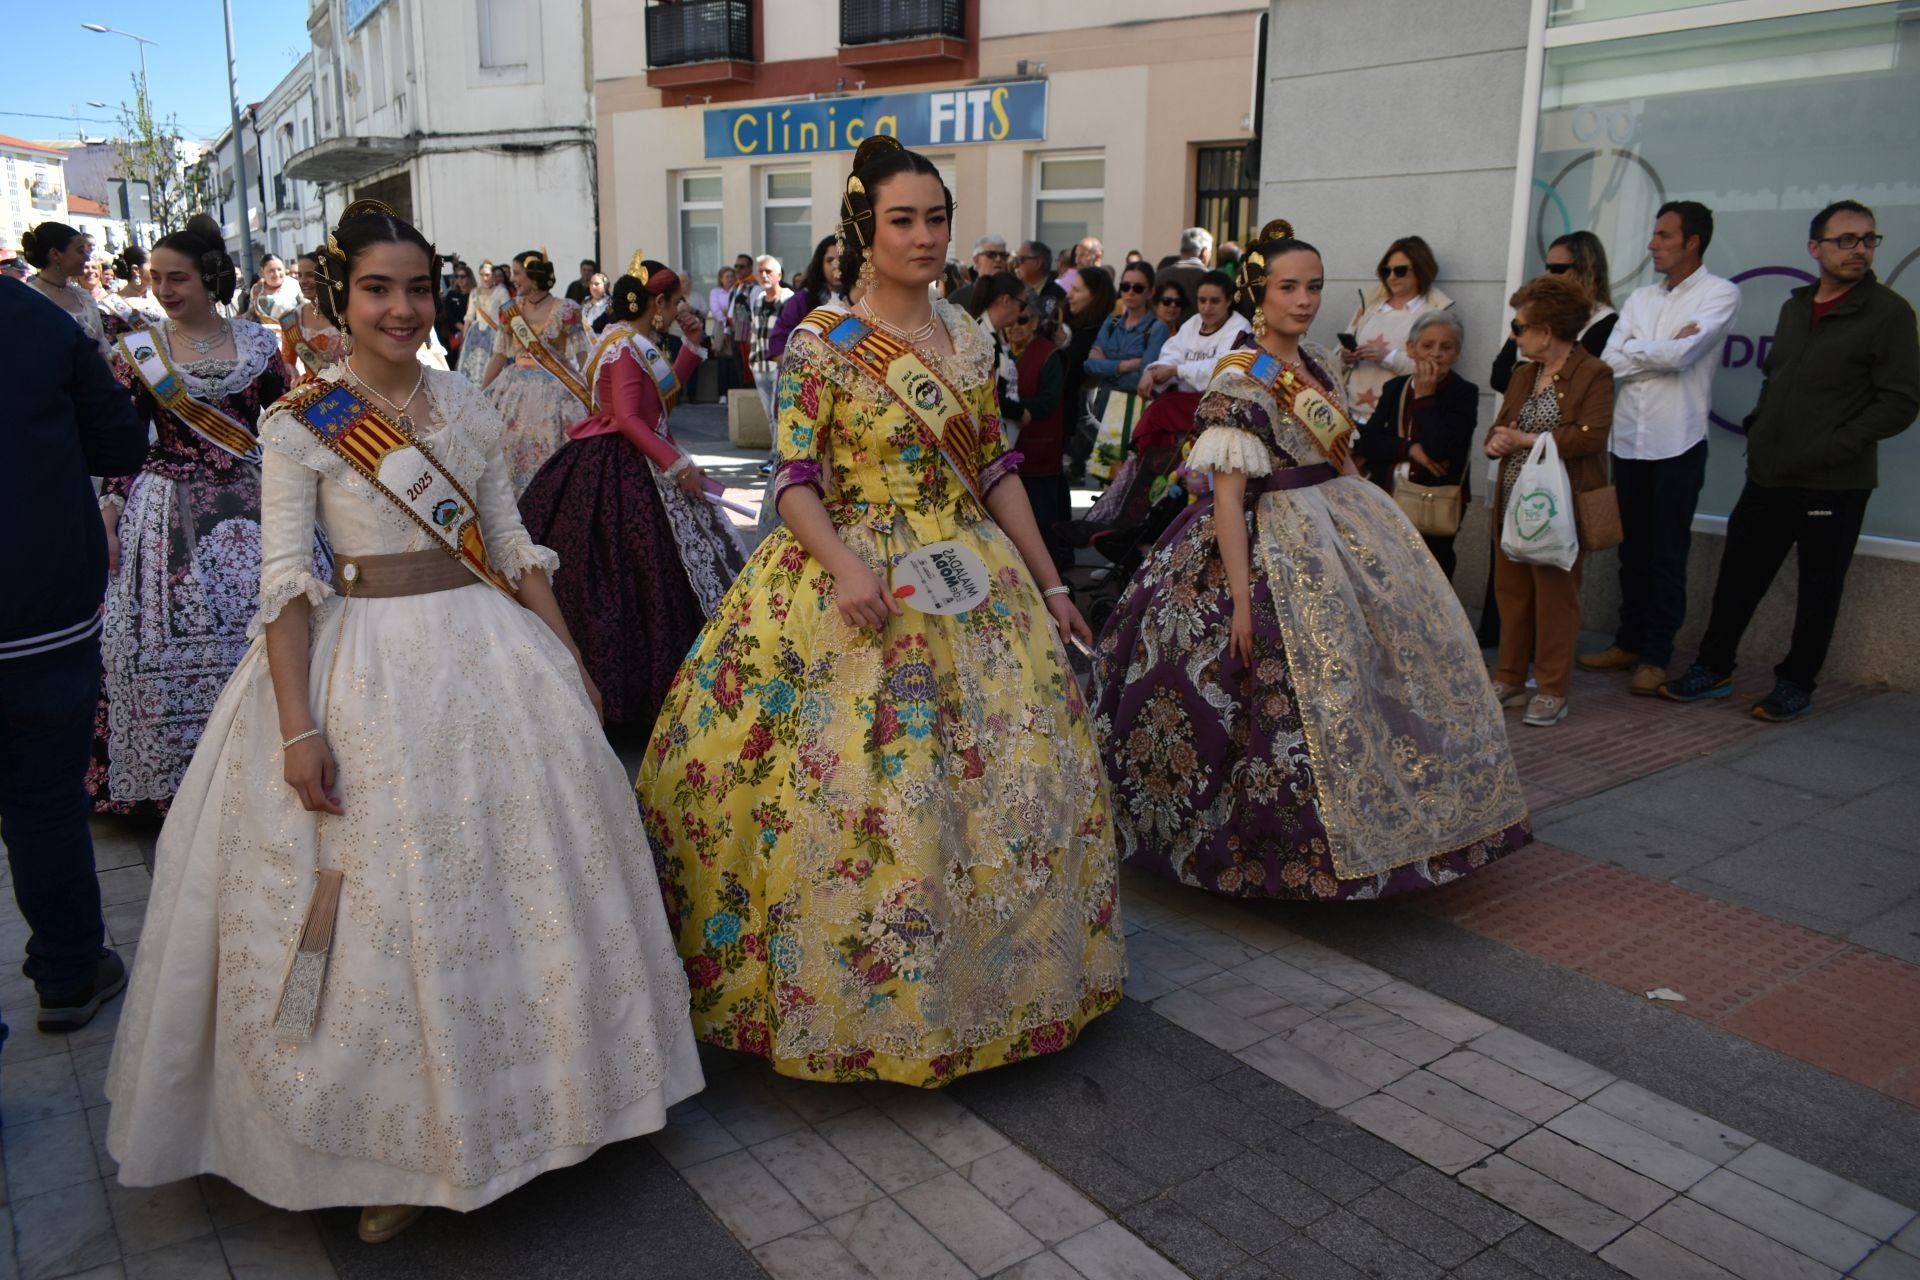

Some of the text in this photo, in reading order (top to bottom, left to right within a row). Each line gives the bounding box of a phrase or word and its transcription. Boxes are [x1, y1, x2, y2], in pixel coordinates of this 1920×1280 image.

[733, 87, 1011, 154] Clínica FITS
[406, 471, 433, 502] 2025
